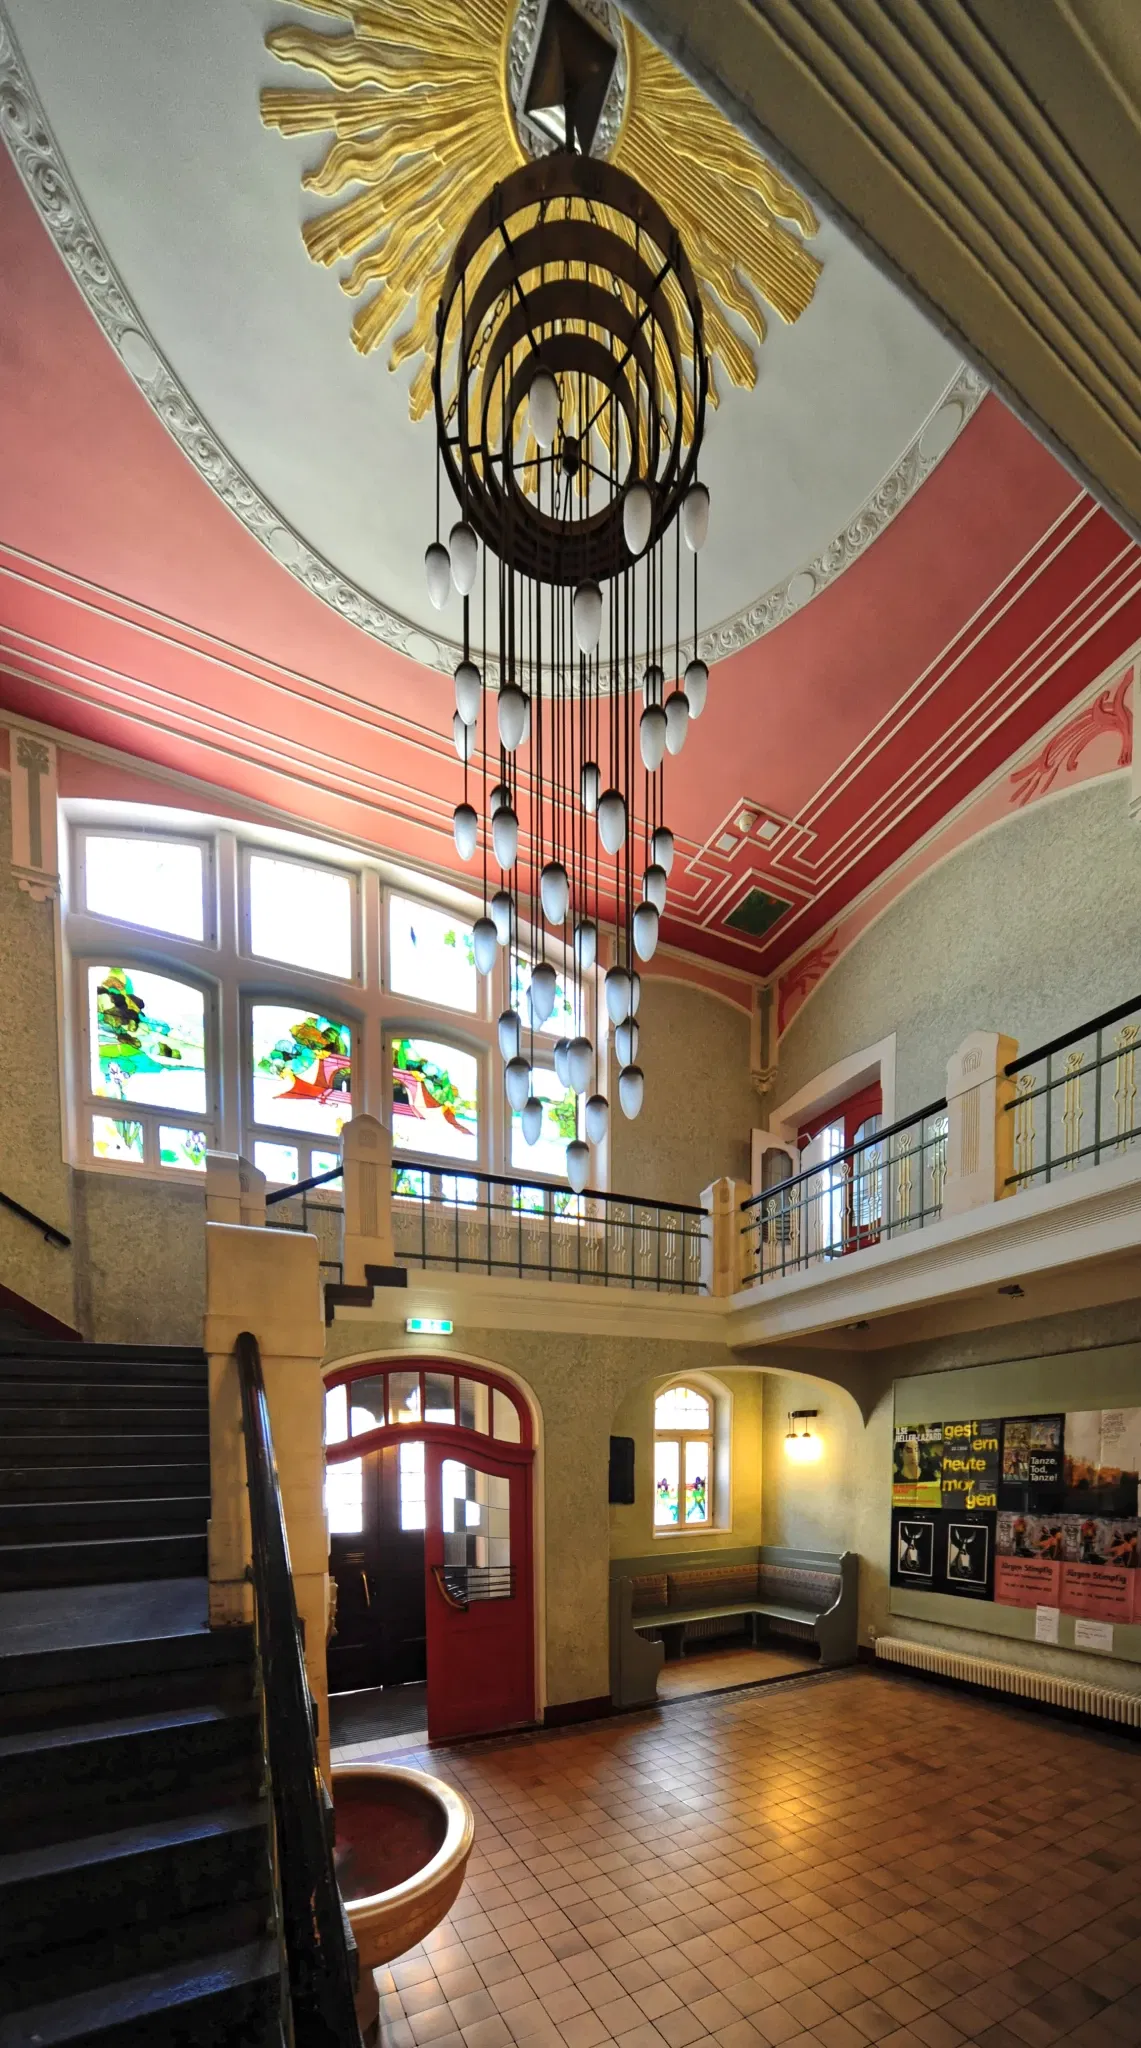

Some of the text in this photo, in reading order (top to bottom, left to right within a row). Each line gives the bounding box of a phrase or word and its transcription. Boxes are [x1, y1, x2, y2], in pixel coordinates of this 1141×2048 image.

[944, 1421, 978, 1440] gest
[972, 1438, 998, 1451] ern
[943, 1457, 986, 1471] heute
[1030, 1457, 1057, 1465] Tanze,
[1030, 1465, 1048, 1474] Tod,
[1030, 1473, 1057, 1482] Tanze!
[942, 1480, 975, 1491] mor
[966, 1494, 997, 1509] gen
